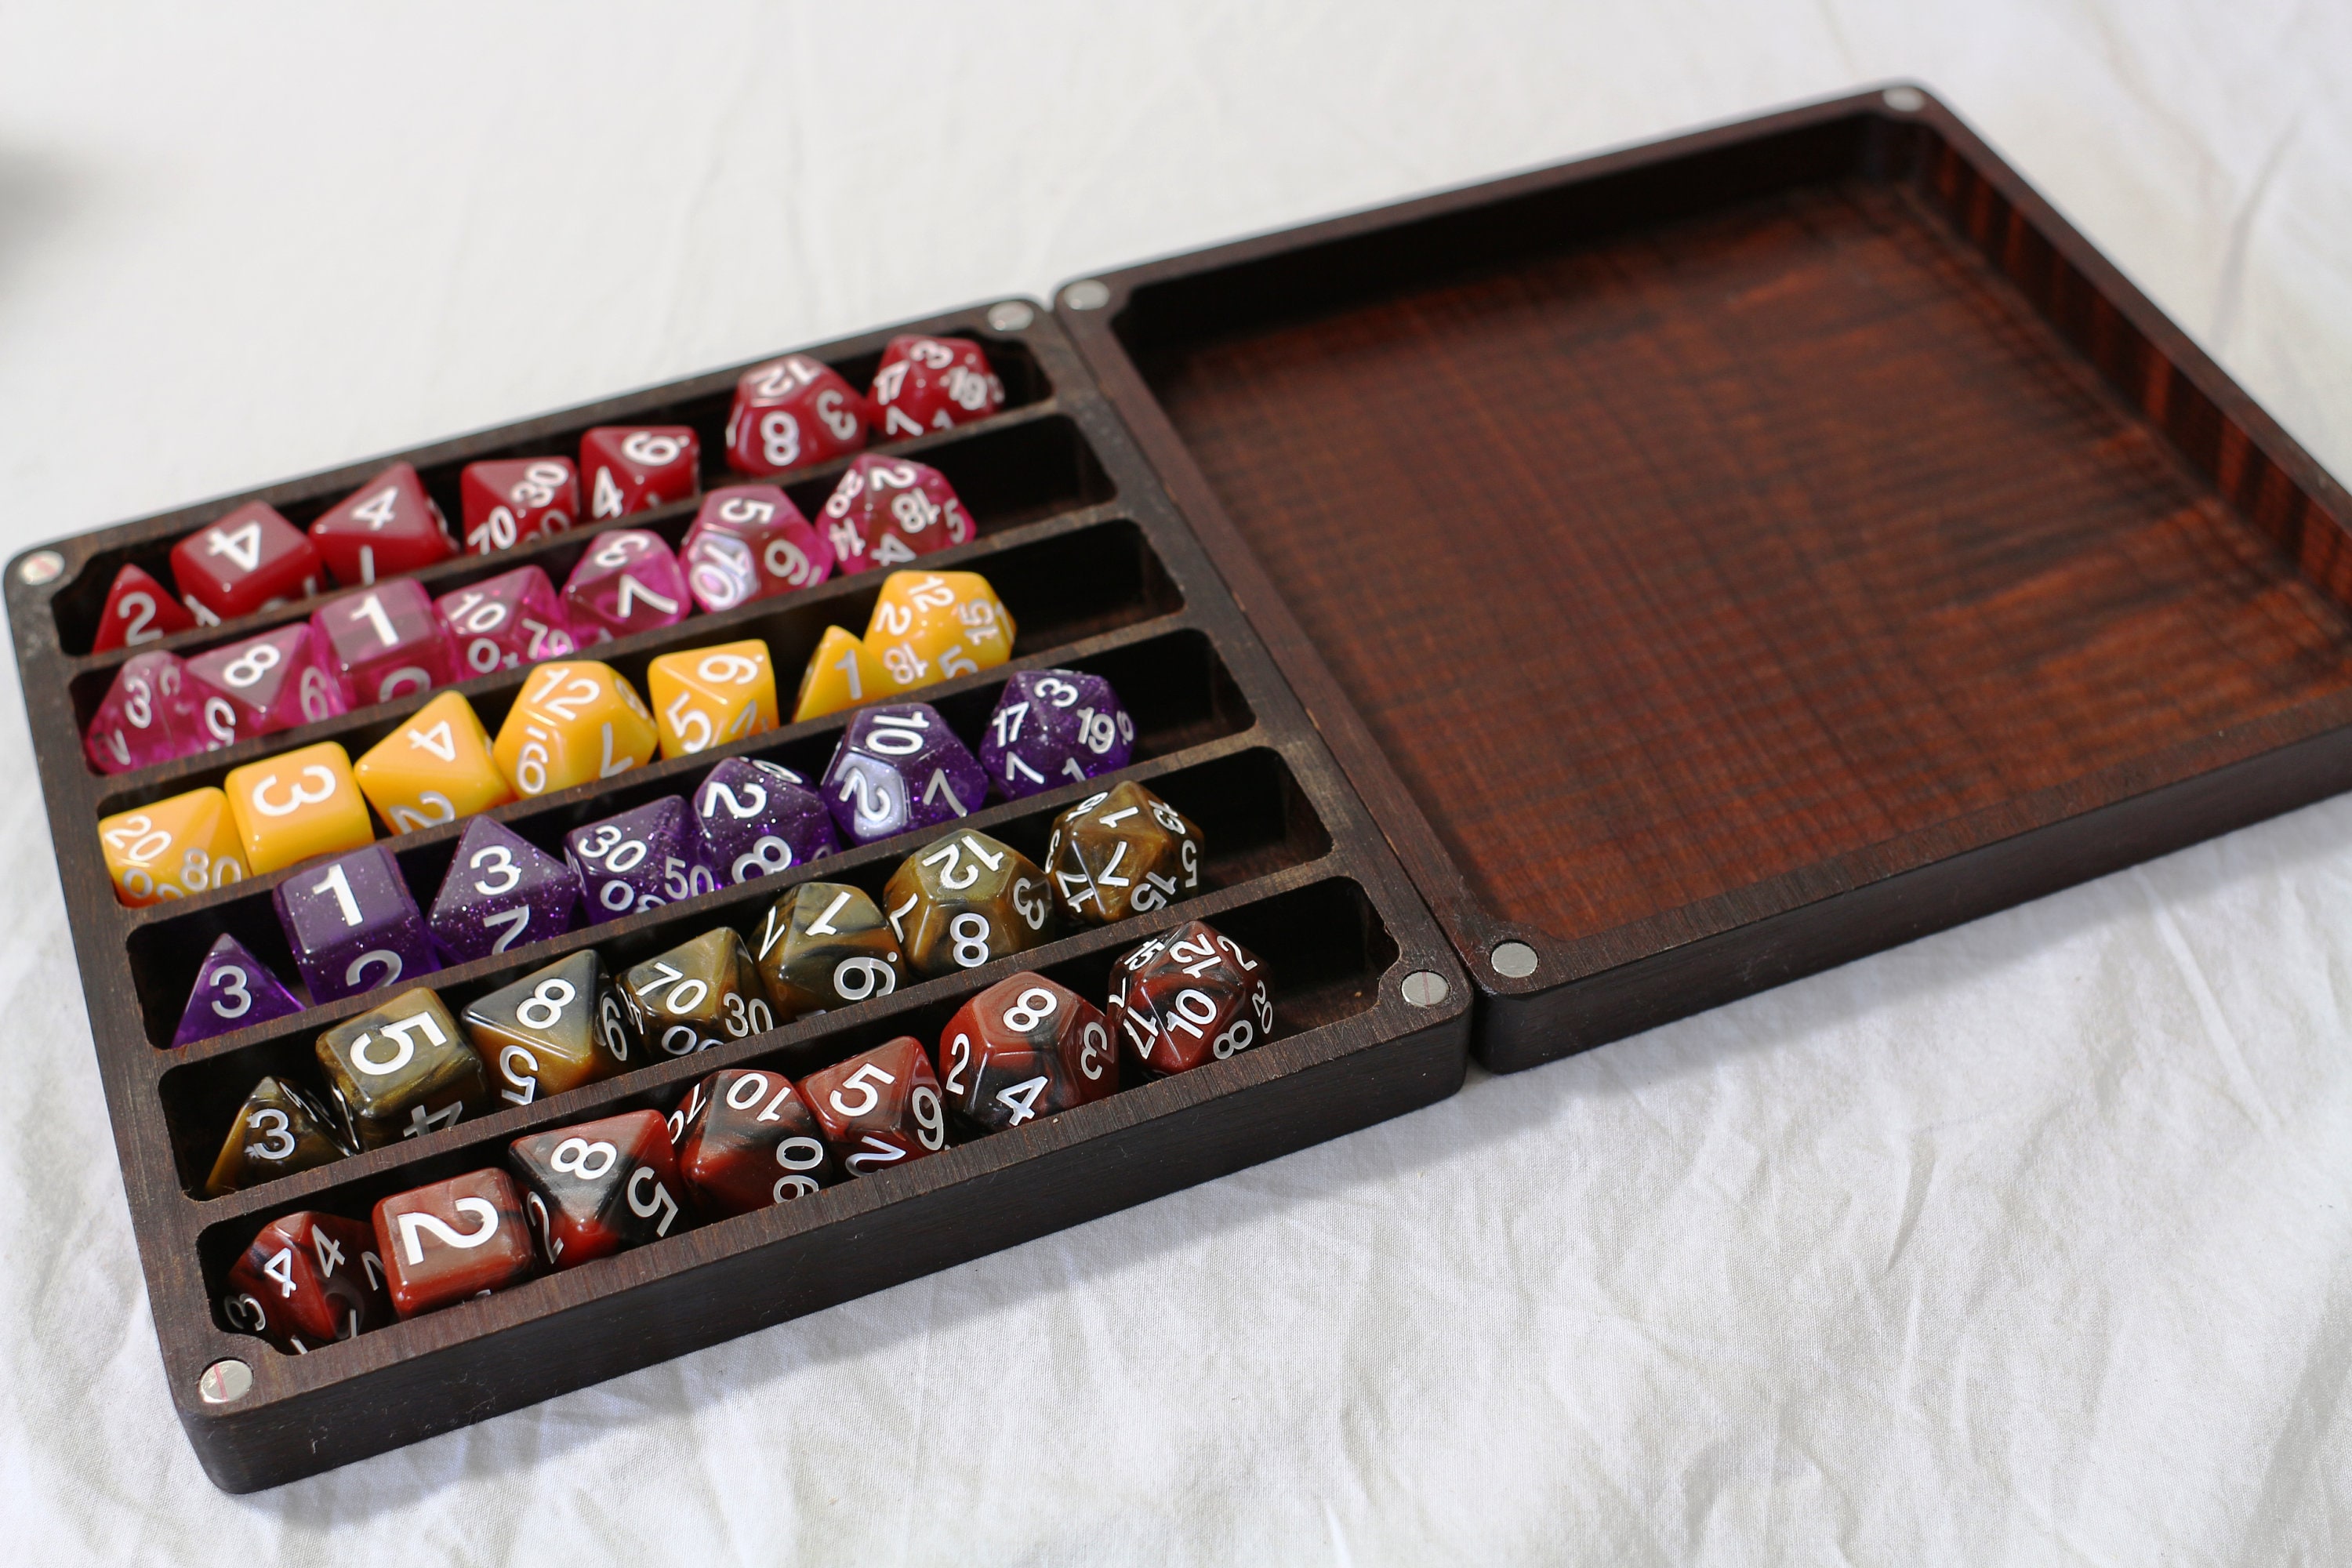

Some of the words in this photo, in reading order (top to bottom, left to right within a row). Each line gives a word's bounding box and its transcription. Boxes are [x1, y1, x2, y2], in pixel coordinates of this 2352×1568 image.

[909, 339, 953, 369] 3
[760, 410, 800, 466] 8
[816, 390, 857, 441] 3
[886, 405, 924, 436] 7
[510, 461, 568, 508] 30
[593, 466, 623, 518] 4
[869, 465, 917, 492] 2
[350, 485, 399, 532] 4
[720, 497, 775, 524] 5
[891, 487, 941, 533] 18
[208, 521, 261, 572] 4
[594, 534, 650, 568] 3
[870, 532, 917, 567] 4
[617, 574, 679, 618] 7
[689, 543, 750, 611] 10
[907, 576, 956, 613] 12
[118, 591, 163, 647] 2
[350, 593, 399, 647] 1
[449, 593, 507, 633] 10
[874, 601, 913, 636] 2
[223, 644, 281, 688] 8
[834, 648, 863, 700] 1
[883, 641, 929, 684] 18
[125, 677, 152, 729] 3
[531, 668, 601, 721] 12
[1033, 677, 1079, 708] 3
[407, 719, 456, 762] 4
[666, 691, 711, 753] 5
[866, 710, 931, 756] 10
[992, 702, 1030, 747] 17
[1076, 706, 1116, 754] 19
[600, 721, 634, 779] 7
[1006, 750, 1045, 784] 7
[252, 764, 337, 817] 3
[389, 790, 456, 835] 2
[702, 781, 768, 818] 2
[838, 767, 891, 822] 2
[922, 768, 968, 818] 7
[104, 815, 172, 861] 20
[1099, 806, 1139, 828] 1
[180, 847, 242, 891] 80
[470, 844, 522, 896] 3
[577, 824, 648, 874] 30
[731, 835, 793, 885] 8
[921, 835, 1005, 890] 12
[1098, 840, 1130, 887] 7
[1181, 838, 1198, 888] 5
[312, 863, 365, 927] 1
[665, 855, 715, 901] 50
[1055, 869, 1095, 913] 17
[1130, 870, 1178, 912] 15
[804, 891, 852, 937] 1
[1013, 877, 1045, 931] 3
[949, 912, 990, 967] 8
[1168, 933, 1222, 979] 12
[1216, 935, 1258, 971] 2
[209, 964, 252, 1019] 3
[516, 978, 576, 1029] 8
[635, 961, 708, 1015] 70
[1003, 987, 1058, 1033] 8
[1251, 979, 1273, 1035] 20
[723, 992, 774, 1038] 30
[1123, 1005, 1160, 1060] 17
[1165, 989, 1218, 1040] 10
[1212, 1019, 1254, 1060] 8
[350, 1011, 448, 1076] 5
[946, 1033, 971, 1095] 2
[1080, 1021, 1108, 1081] 3
[499, 1044, 539, 1105] 5
[726, 1073, 792, 1123] 10
[829, 1062, 895, 1117] 5
[995, 1075, 1048, 1127] 4
[245, 1108, 296, 1160] 3
[550, 1137, 618, 1180] 8
[627, 1166, 679, 1238] 5
[310, 1223, 346, 1279] 4
[397, 1196, 499, 1267] 2
[526, 1190, 564, 1265] 2
[263, 1247, 297, 1299] 4
[223, 1293, 267, 1332] 3
